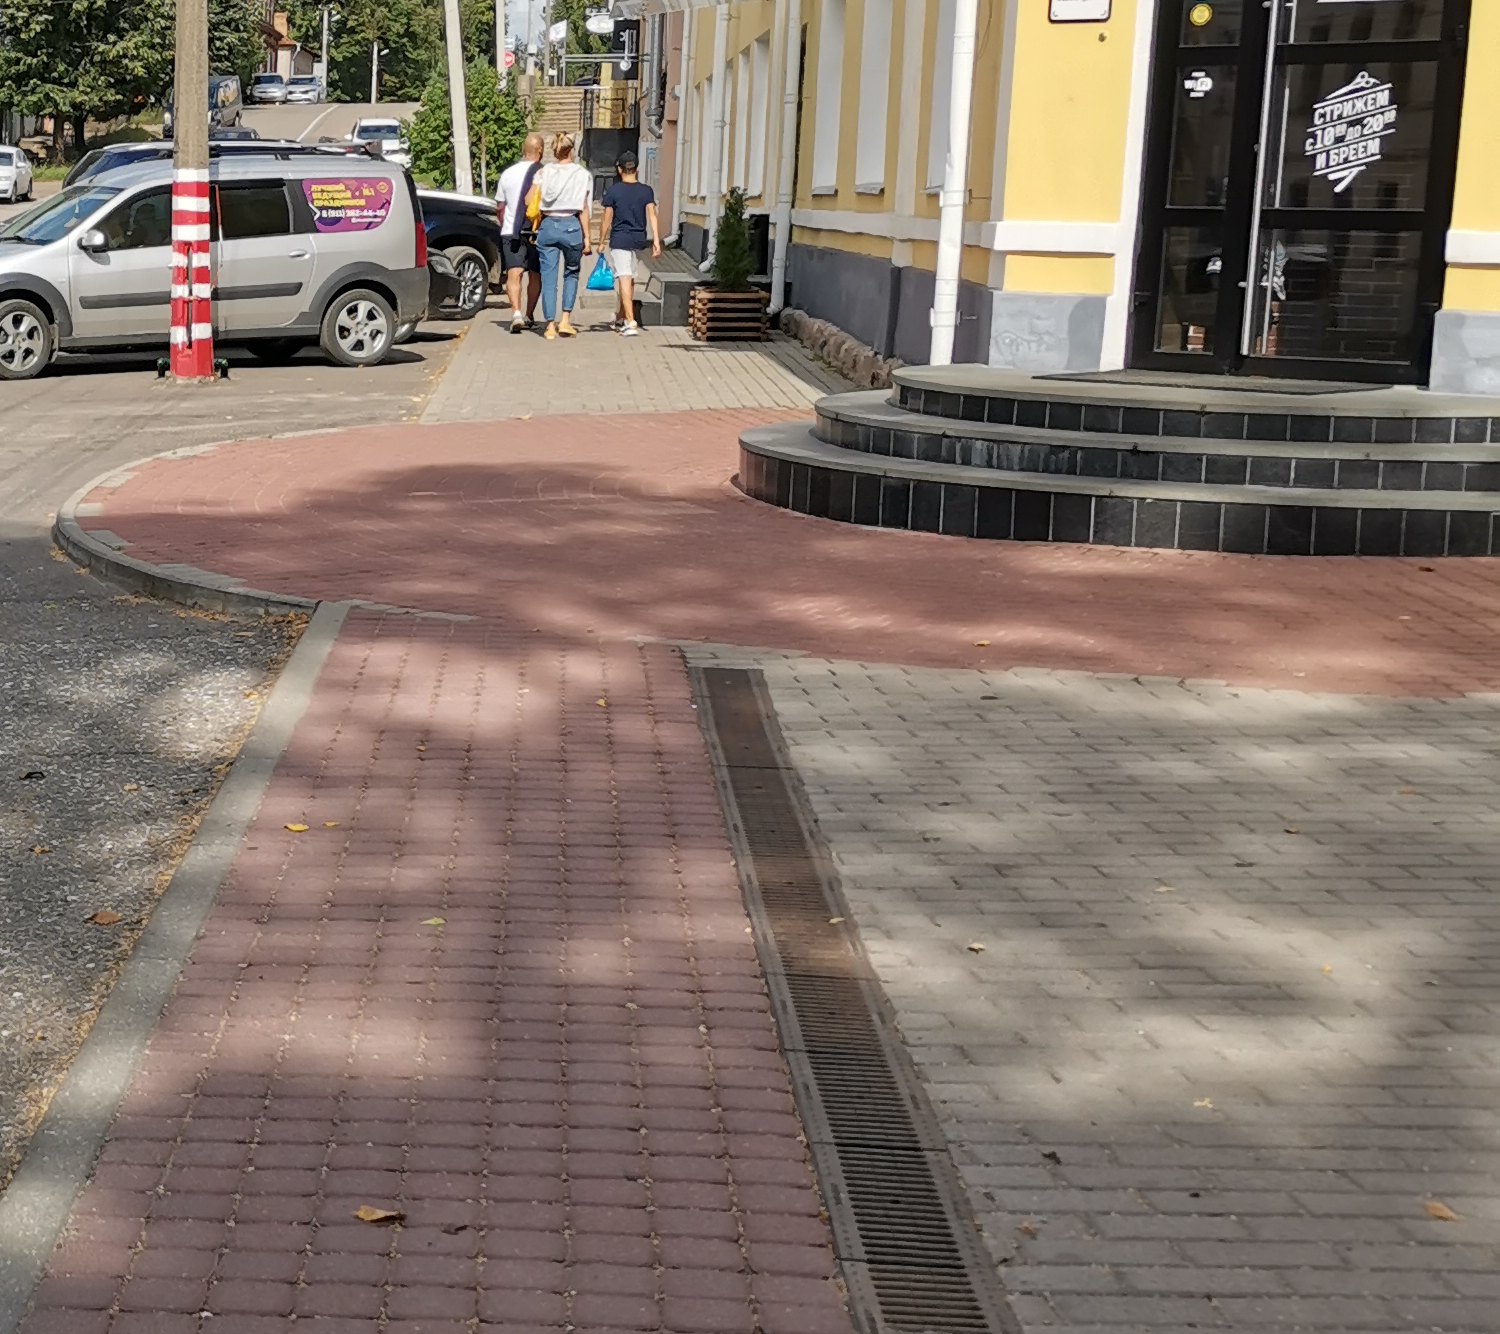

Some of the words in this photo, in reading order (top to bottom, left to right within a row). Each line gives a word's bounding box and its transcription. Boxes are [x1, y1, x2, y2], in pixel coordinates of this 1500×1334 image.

[1313, 89, 1390, 125] СТРИЖЕМ
[1315, 153, 1327, 169] И
[1328, 137, 1381, 166] БРЕЕМ
